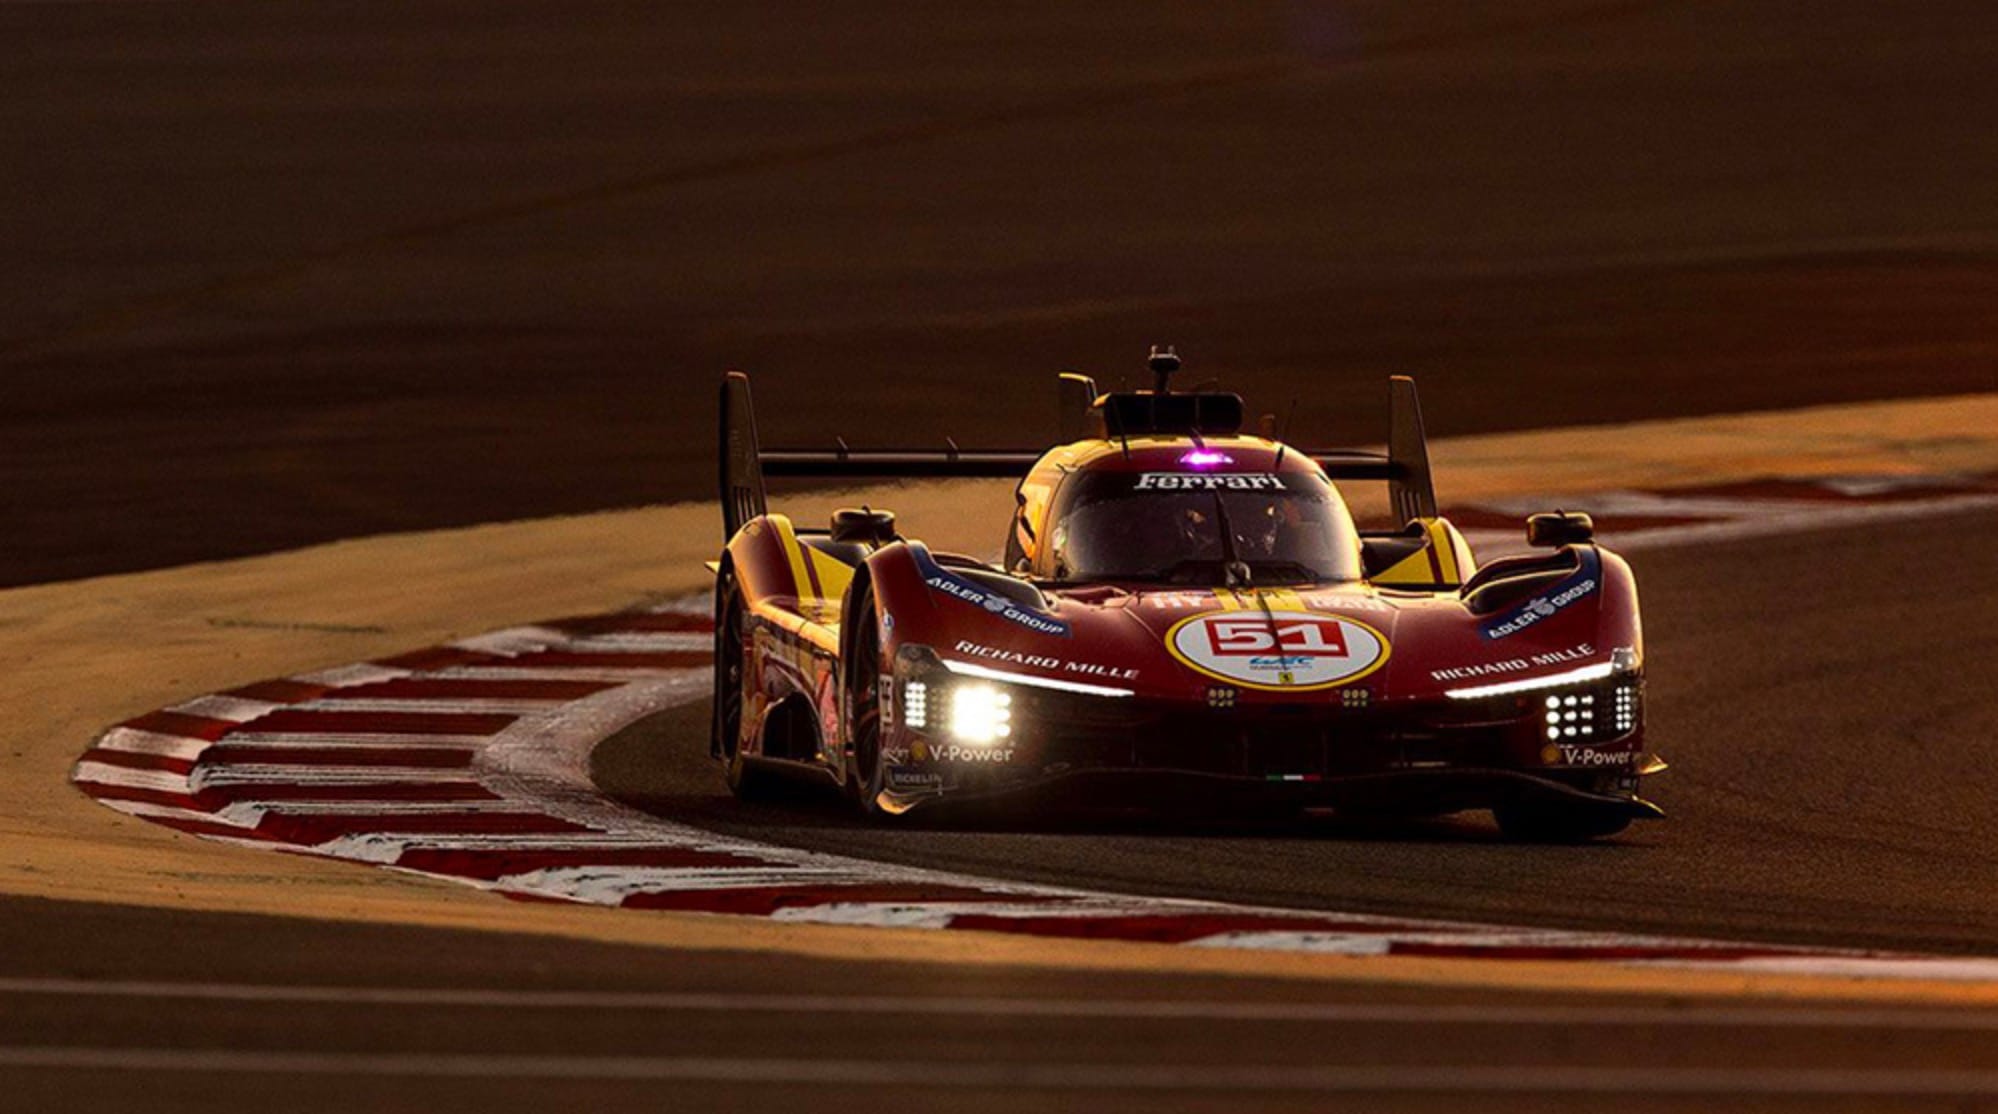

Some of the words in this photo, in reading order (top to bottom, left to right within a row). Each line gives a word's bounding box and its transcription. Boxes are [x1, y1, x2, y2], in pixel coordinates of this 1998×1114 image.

[1134, 472, 1287, 490] Ferrari
[926, 576, 985, 604] ADLER
[1003, 607, 1064, 633] GROUP
[1488, 611, 1540, 638] ADLER
[1551, 579, 1595, 607] GROUP
[1214, 622, 1341, 651] 51
[955, 640, 1059, 669] RICHARD
[1064, 661, 1140, 680] MILLE
[1431, 658, 1530, 681] RICHARD
[1531, 643, 1596, 666] MILLE
[929, 744, 1014, 761] V-Power
[1565, 749, 1631, 765] V-Power
